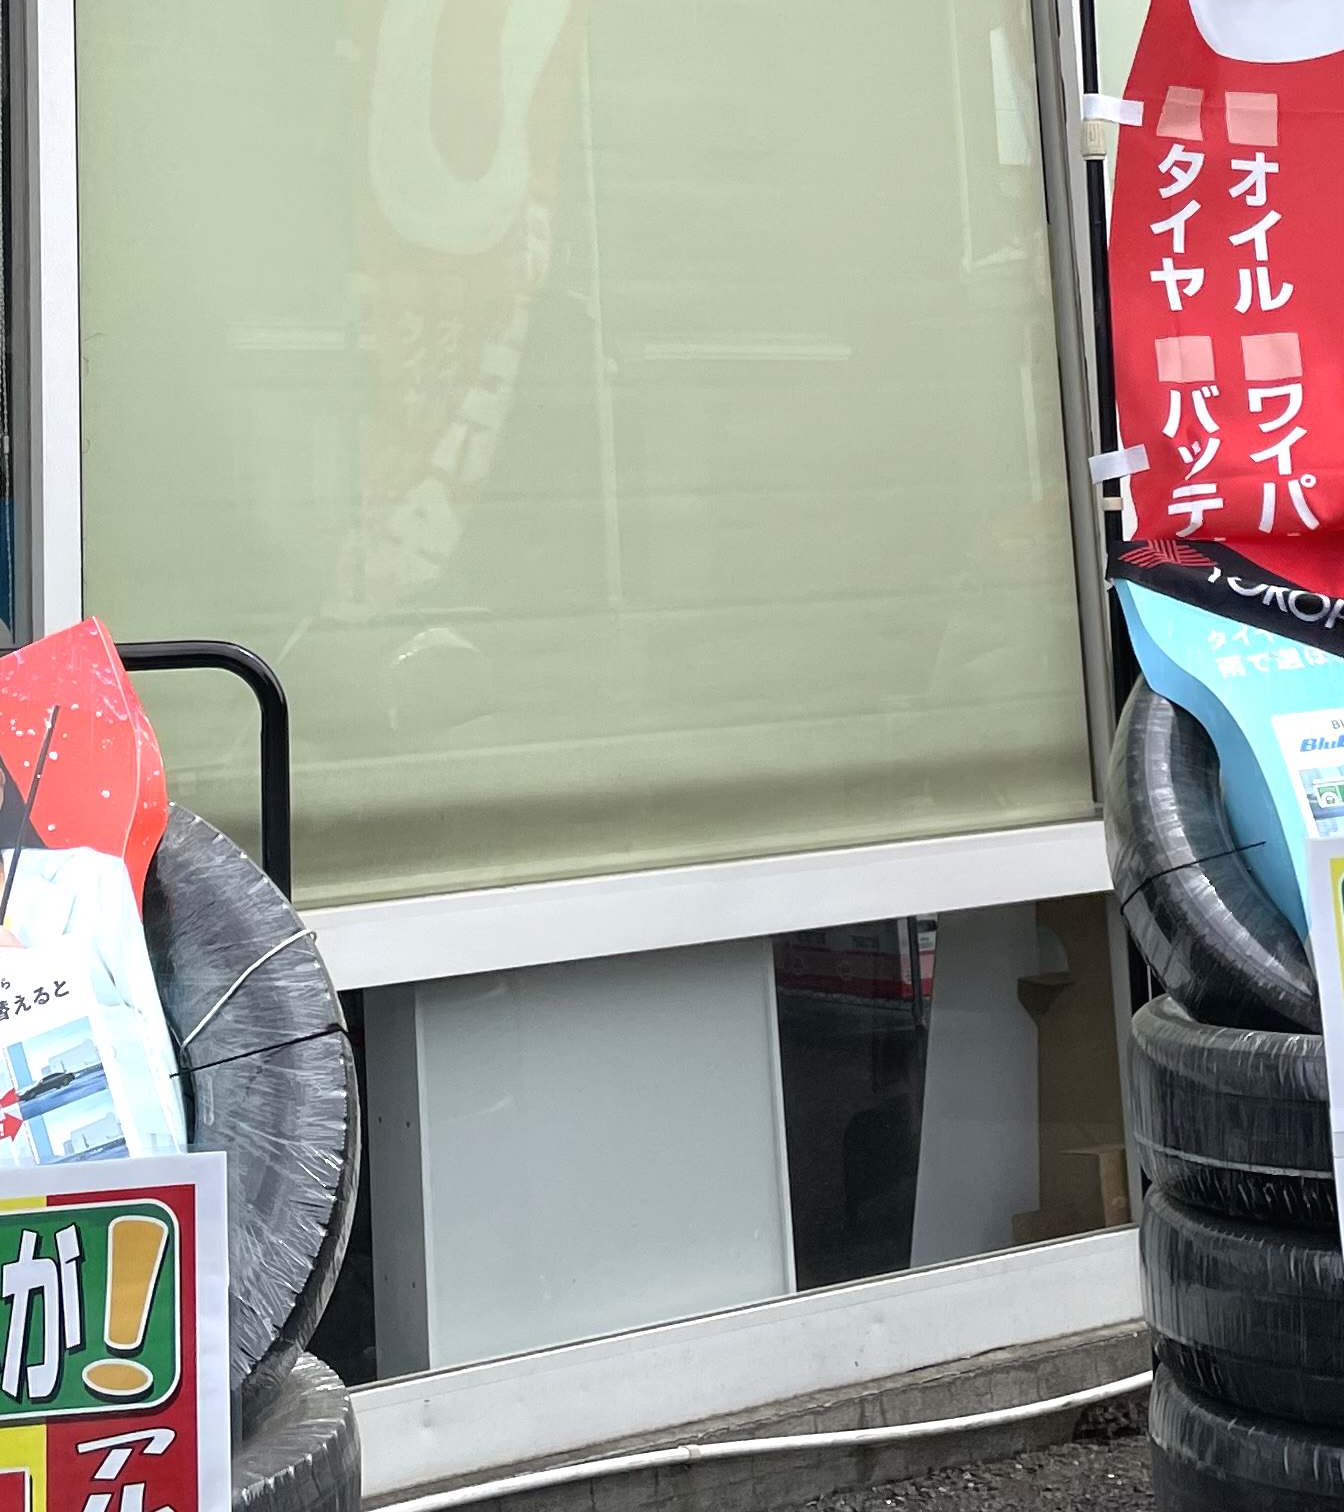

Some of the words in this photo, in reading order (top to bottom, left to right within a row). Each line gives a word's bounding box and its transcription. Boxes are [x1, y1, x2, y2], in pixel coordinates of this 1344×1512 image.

[1149, 144, 1206, 312] タイヤ
[1227, 152, 1294, 314] オイル
[1161, 385, 1227, 541] バッテ
[1247, 383, 1321, 537] ワイパ
